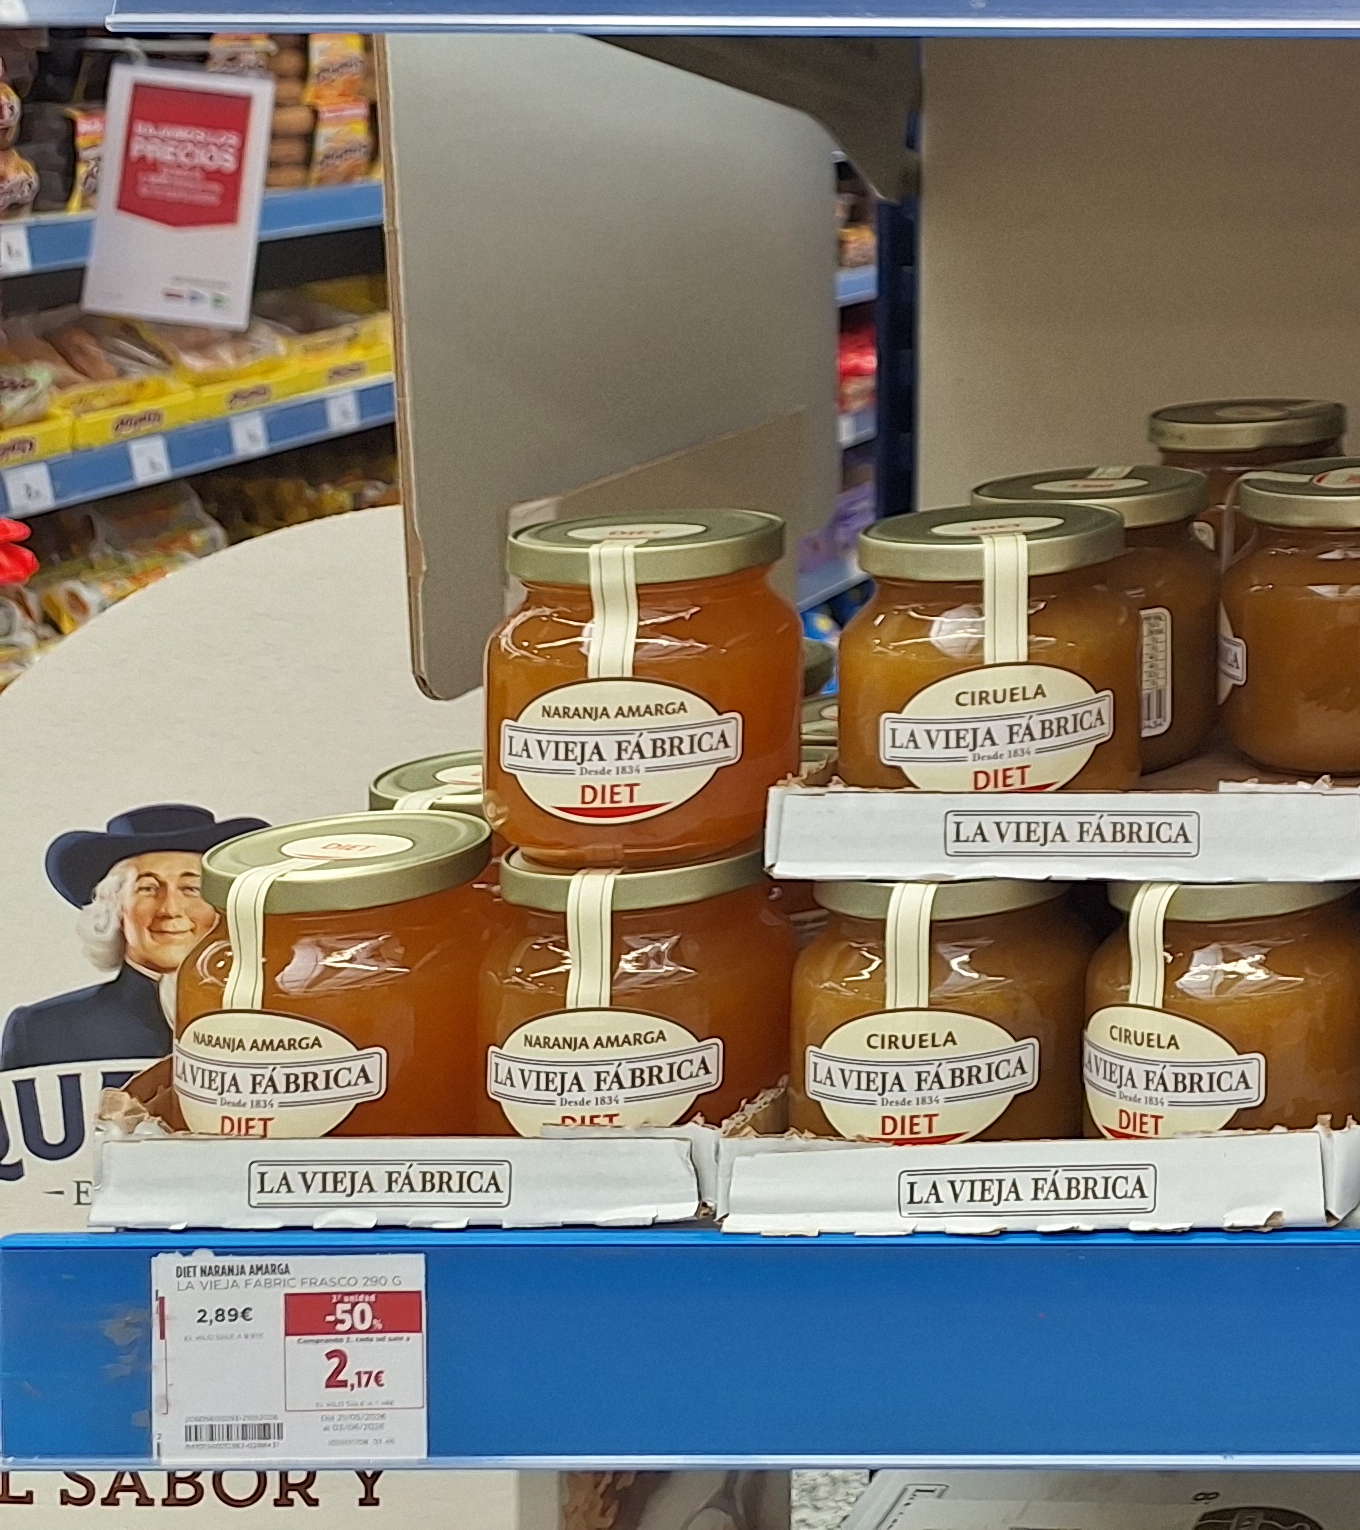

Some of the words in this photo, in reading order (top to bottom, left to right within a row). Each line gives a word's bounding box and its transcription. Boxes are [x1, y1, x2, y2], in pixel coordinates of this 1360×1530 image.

[956, 684, 1046, 706] CIRUELA
[542, 706, 610, 721] NARANJA
[614, 701, 687, 718] AMARGA
[889, 727, 921, 753] LA
[923, 726, 996, 754] VIEJA
[1007, 707, 1106, 744] FÁBRICA
[508, 735, 533, 760] LA
[534, 741, 606, 765] VIEJA
[615, 729, 731, 761] FÁBRICA
[972, 751, 1004, 762] Desde
[1007, 748, 1032, 759] 1834
[580, 767, 612, 777] Desde
[615, 765, 641, 775] 1834
[974, 766, 1031, 791] DIET
[581, 783, 640, 804] DIET
[322, 842, 374, 854] DIET
[193, 1032, 247, 1053] NARANJA
[250, 1036, 322, 1052] AMARGA
[257, 1172, 294, 1193] LA
[299, 1172, 377, 1196] VIEJA
[384, 1164, 503, 1194] FÁBRICA
[175, 1265, 196, 1277] DIET
[199, 1264, 245, 1276] NARANJA
[248, 1263, 289, 1275] AMARGA
[177, 1279, 193, 1290] LA
[198, 1279, 239, 1289] VIEJA
[244, 1277, 295, 1289] FABRIC
[300, 1276, 357, 1287] FRASCO
[361, 1275, 386, 1285] 290
[391, 1275, 401, 1285] G
[195, 1306, 252, 1325] 2,89€
[324, 1347, 384, 1391] 2,17€
